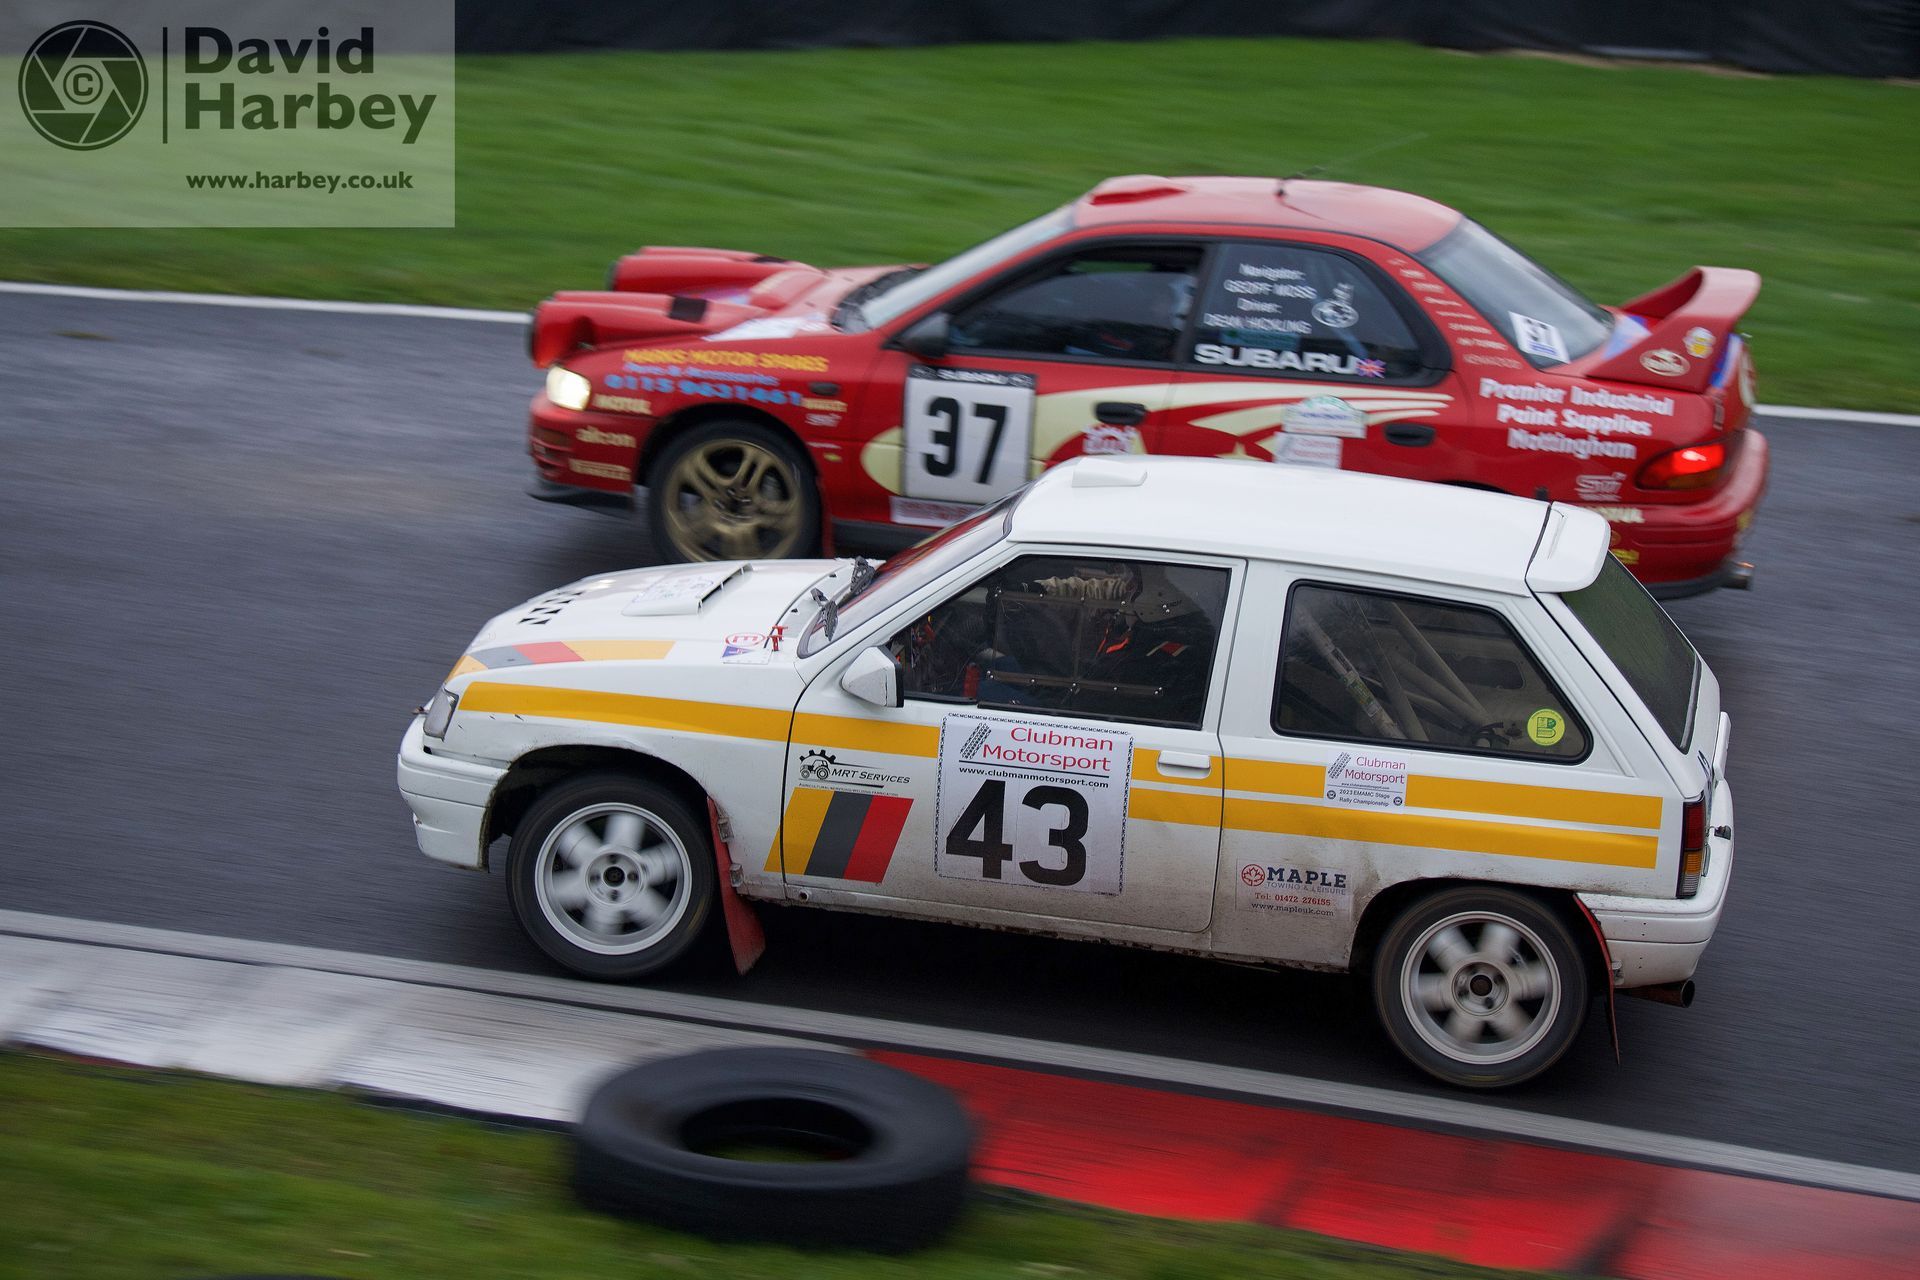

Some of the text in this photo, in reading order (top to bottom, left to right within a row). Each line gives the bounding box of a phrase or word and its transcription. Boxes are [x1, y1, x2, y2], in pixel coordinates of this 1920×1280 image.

[689, 349, 758, 367] MOTOR
[1194, 343, 1361, 375] SUBARU
[1479, 376, 1675, 417] Premier Industrial
[1496, 402, 1653, 436] Paint Supplies
[923, 396, 1010, 486] 37
[1507, 427, 1637, 460] Nottingham
[1011, 727, 1113, 751] Clubman
[982, 744, 1111, 771] Motorsport
[1356, 756, 1406, 770] Clubman
[832, 768, 911, 784] MRT SERVICES
[959, 766, 1109, 788] www.clubmanmotorsport.com
[1344, 769, 1405, 784] Motorsport
[1353, 798, 1390, 807] Championship
[1375, 792, 1390, 800] Stage
[946, 779, 1089, 887] 43
[1266, 881, 1301, 891] TOWING
[1311, 885, 1346, 896] LEISURE
[1267, 866, 1347, 889] MAPLE
[1274, 894, 1299, 904] 01472
[1302, 896, 1331, 906] 276155
